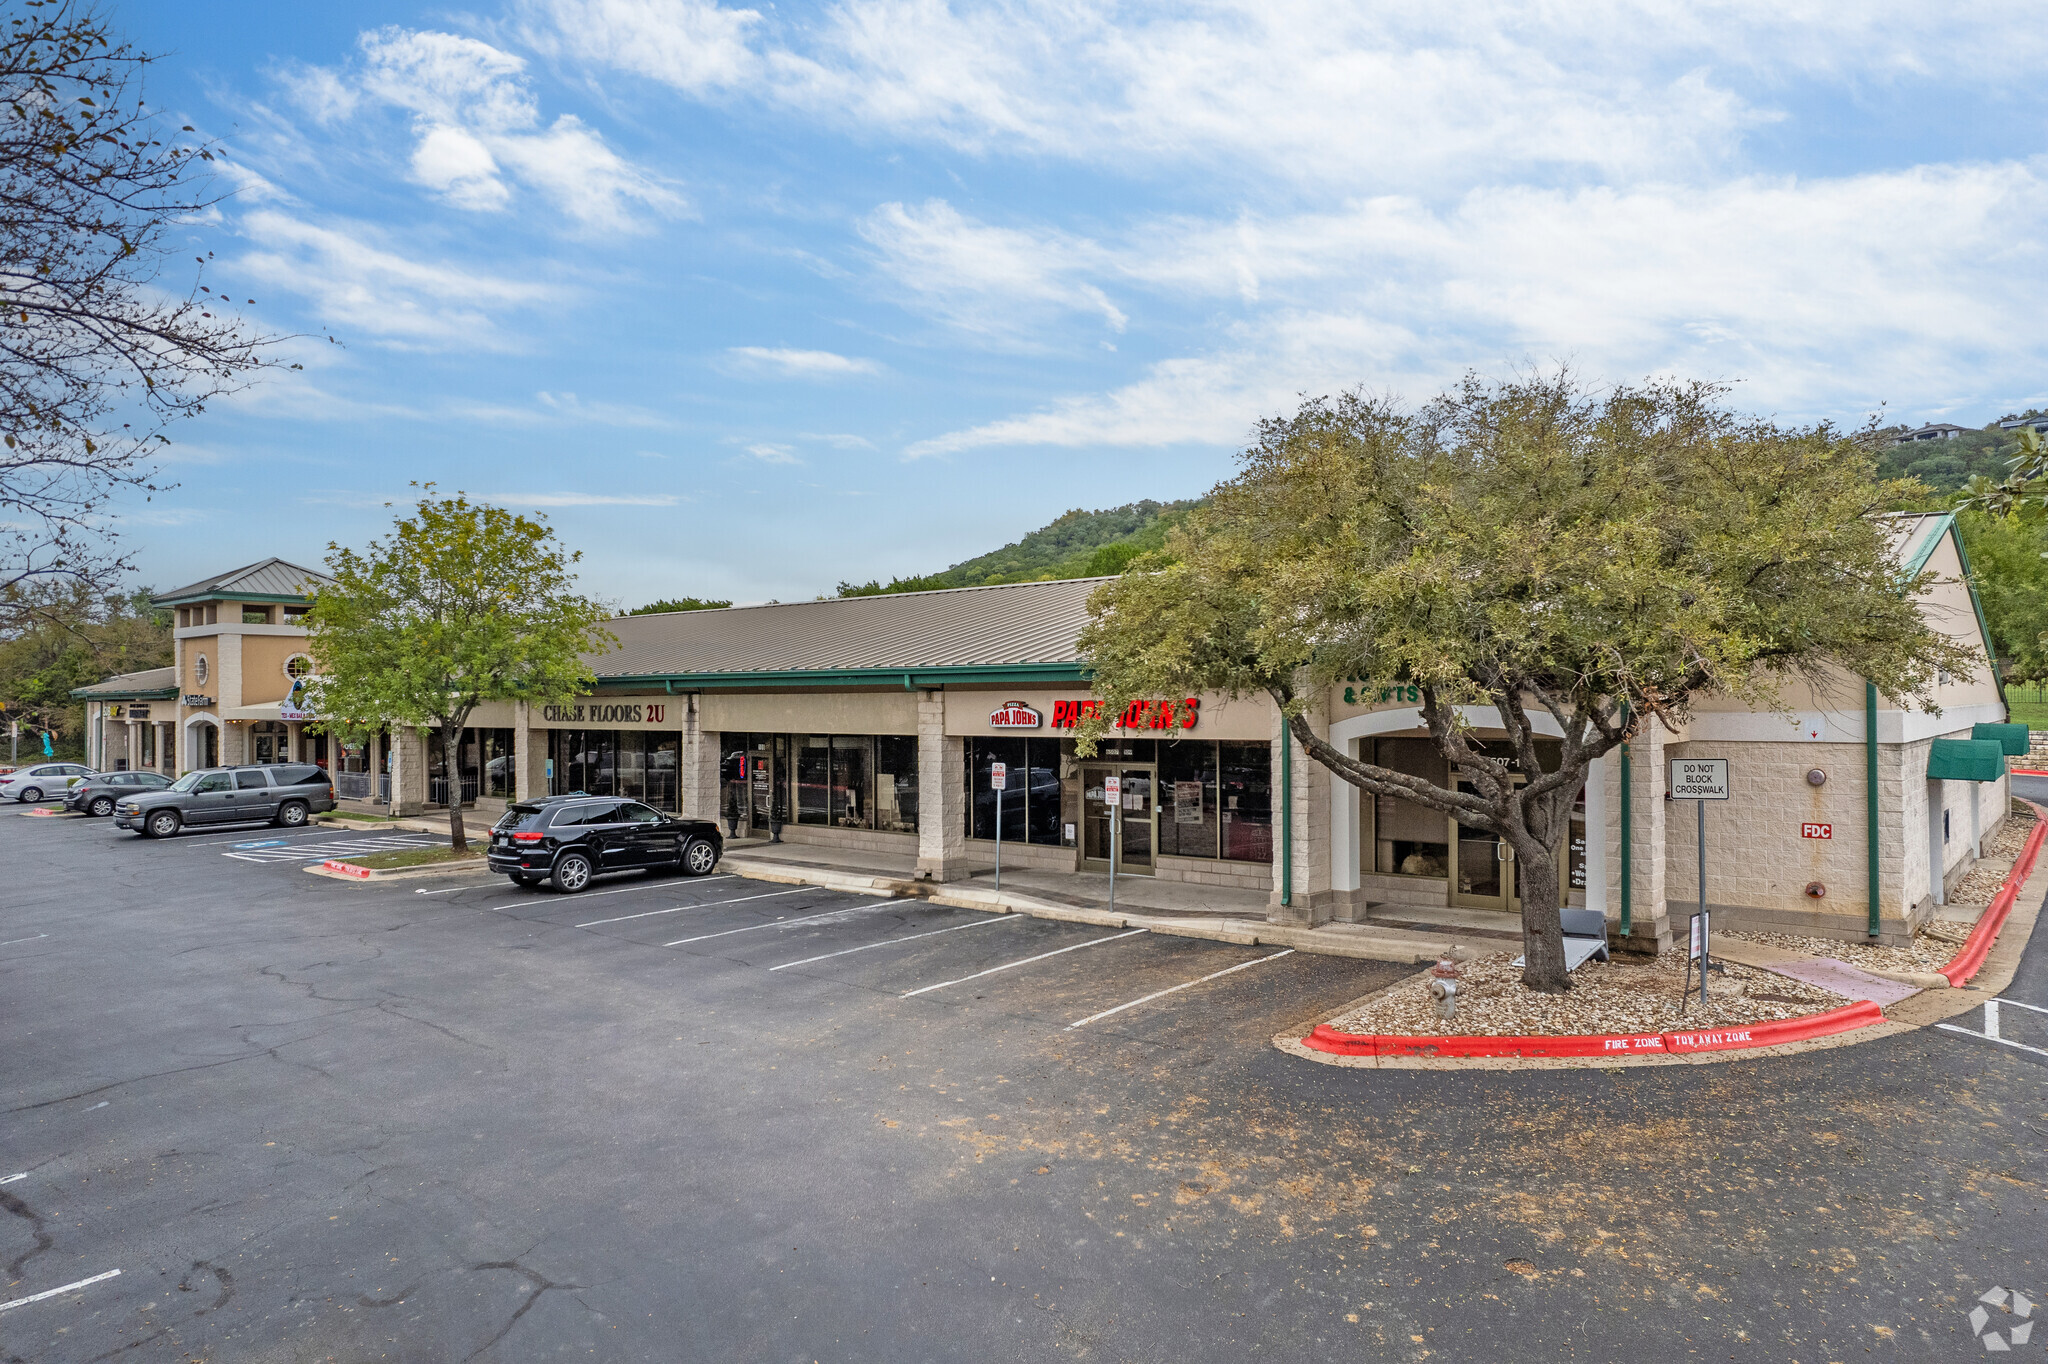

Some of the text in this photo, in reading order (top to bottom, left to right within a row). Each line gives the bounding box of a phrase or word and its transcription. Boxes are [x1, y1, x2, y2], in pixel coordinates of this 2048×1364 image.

[1343, 686, 1356, 704] &
[543, 704, 665, 723] CHASE FLOORS 2U
[991, 710, 1010, 725] PAPA
[1051, 700, 1105, 728] PAP
[1684, 764, 1714, 773] DO NOT
[1686, 775, 1712, 783] BLOCK
[1675, 785, 1724, 794] CROSSWALK
[1803, 824, 1830, 838] FDC
[1604, 1031, 1752, 1050] FIRE ZONE TOW AWAY ZONE
